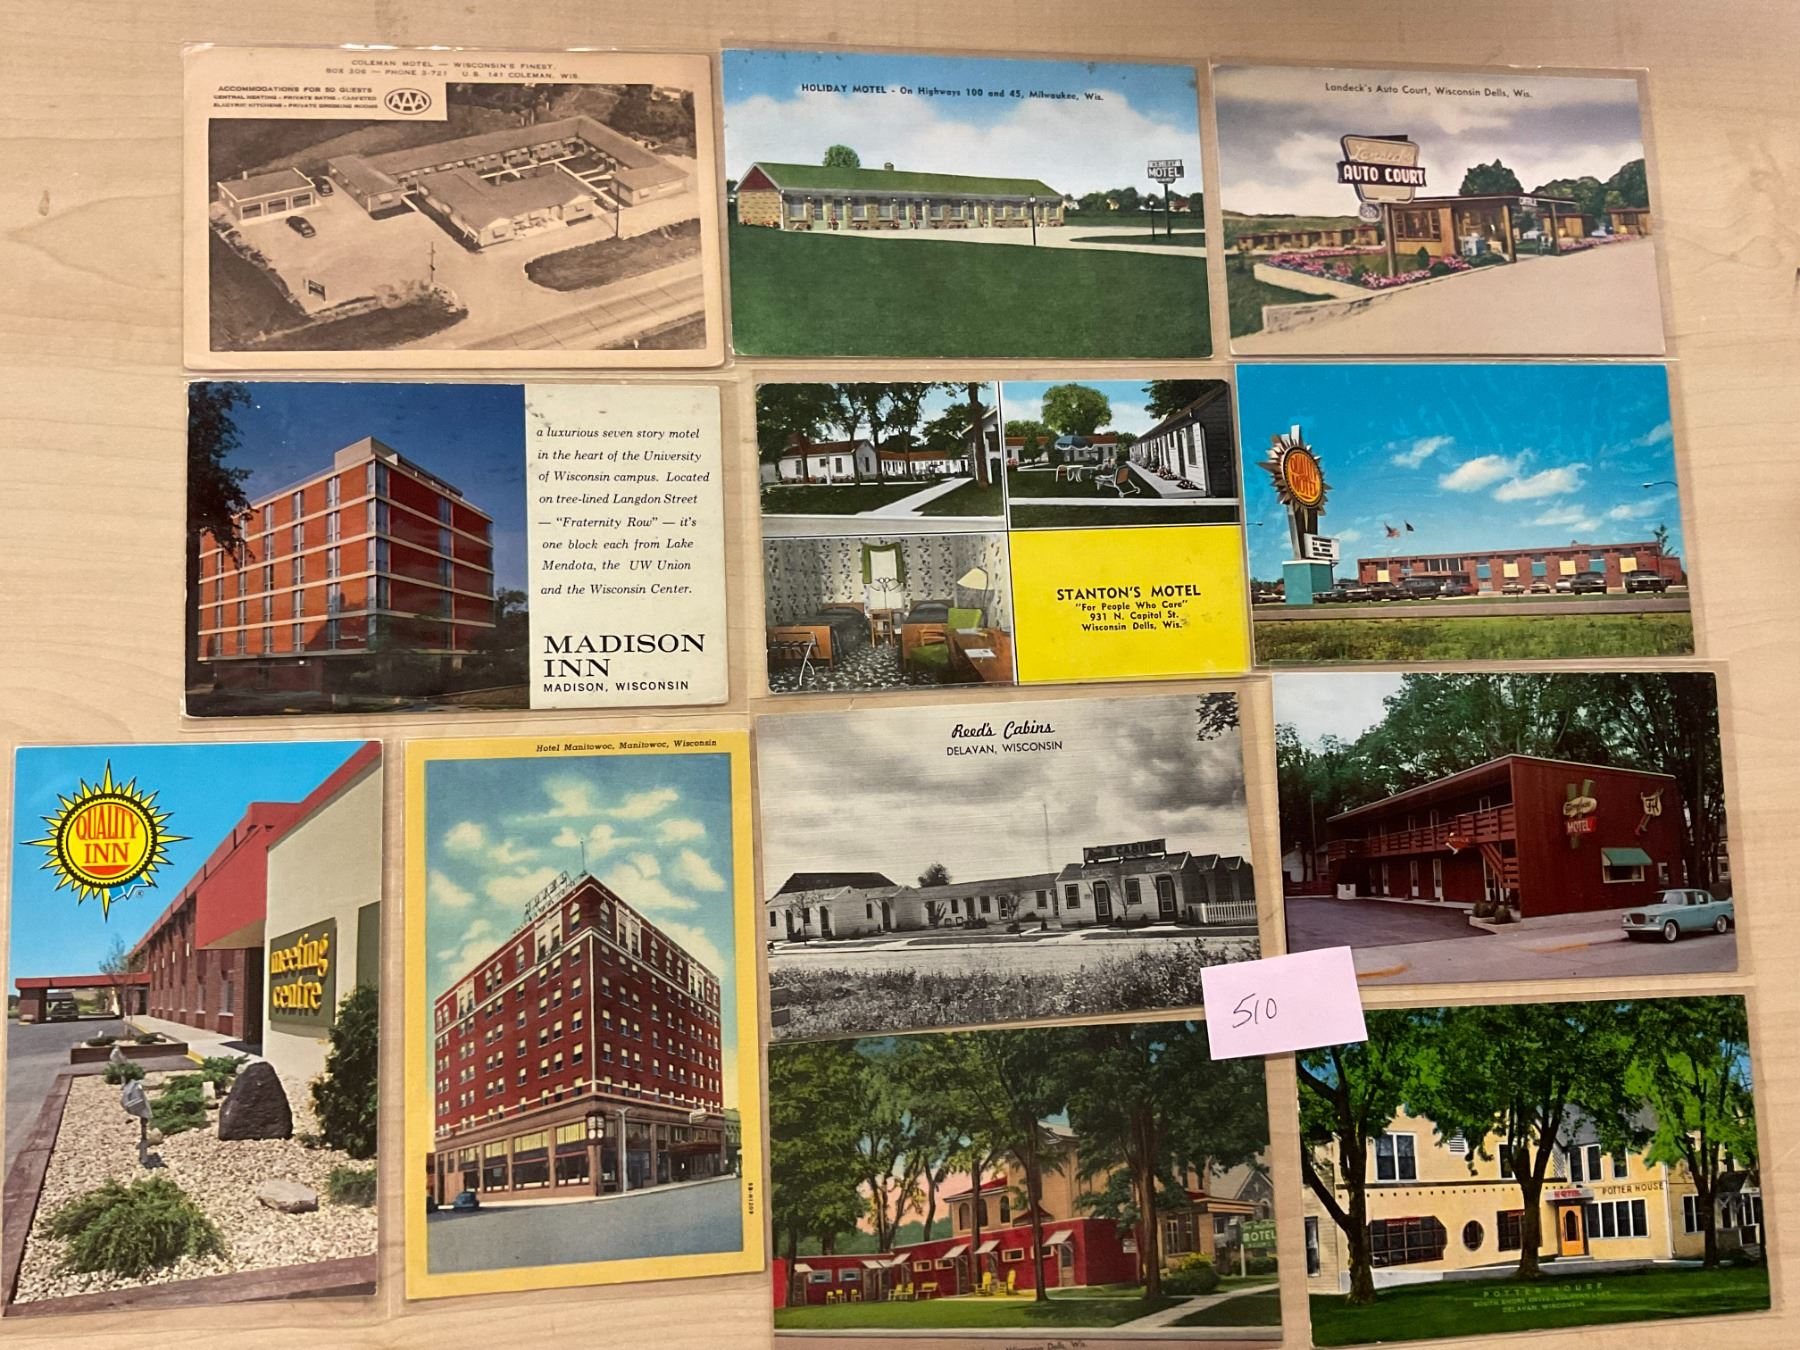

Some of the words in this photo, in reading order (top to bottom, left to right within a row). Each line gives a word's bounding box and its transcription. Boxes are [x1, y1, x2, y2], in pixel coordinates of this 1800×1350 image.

[351, 59, 396, 67] COLEMAN
[402, 60, 433, 68] MOTEL
[453, 61, 515, 69] WISCONSIN'S
[325, 67, 344, 75] BOX
[801, 83, 848, 93] HOLIDAY
[852, 84, 887, 94] MOTEL
[899, 86, 913, 95] On
[917, 87, 961, 97] Highways
[965, 88, 983, 97] 100
[987, 89, 1005, 98] and
[1009, 89, 1025, 99] 45,
[1029, 90, 1079, 101] Milwaukee,
[1084, 92, 1104, 101] Wis.
[1325, 82, 1372, 93] Landeck's
[1376, 84, 1398, 94] Auto
[1401, 86, 1431, 96] Court,
[1435, 86, 1480, 97] Wisconsin
[1484, 87, 1510, 98] Dells,
[1513, 89, 1533, 98] Wis.
[1148, 167, 1180, 177] MOTEL
[1343, 164, 1378, 182] AUTO
[1384, 167, 1424, 185] COURT
[547, 428, 599, 437] luxurious
[602, 430, 633, 438] seven
[636, 430, 664, 440] story
[668, 429, 699, 438] motel
[537, 450, 549, 459] in
[552, 450, 571, 460] the
[574, 450, 603, 460] heart
[607, 450, 619, 462] of
[622, 450, 640, 460] the
[643, 450, 702, 463] University
[538, 471, 550, 482] of
[554, 471, 610, 481] Wisconsin
[613, 473, 659, 483] campus.
[666, 472, 710, 482] Located
[539, 496, 553, 504] on
[556, 494, 609, 504] tree-lined
[613, 494, 661, 505] Langdon
[663, 493, 698, 503] Street
[542, 541, 562, 549] one
[568, 539, 598, 549] block
[603, 539, 629, 549] each
[634, 538, 660, 550] from
[666, 538, 694, 549] Lake
[542, 560, 597, 572] Mendota,
[602, 560, 620, 570] the
[629, 560, 652, 571] UW
[657, 559, 691, 570] Union
[541, 585, 562, 595] and
[567, 584, 586, 594] the
[590, 584, 645, 594] Wisconsin
[650, 583, 692, 594] Center.
[1057, 586, 1141, 601] STANTON'S
[1151, 584, 1201, 598] MOTEL
[1101, 602, 1130, 611] People
[1136, 601, 1156, 609] Who
[1090, 613, 1106, 621] 931
[1113, 612, 1125, 620] N.
[1167, 610, 1179, 619] St.
[1081, 623, 1126, 632] Wisconsin
[1132, 621, 1157, 631] Dells,
[1162, 620, 1183, 629] Wis.
[543, 633, 705, 654] MADISON
[543, 658, 611, 678] INN
[543, 682, 609, 693] MADISON,
[615, 681, 689, 691] WISCONSIN
[951, 722, 997, 738] Reed's
[1003, 719, 1055, 739] Cabins
[535, 744, 560, 752] Hotel
[563, 742, 615, 751] Manitowoc,
[619, 740, 669, 749] Manitowoc,
[673, 739, 717, 747] Wisconsin
[946, 745, 997, 756] DELAVAN,
[1002, 741, 1063, 752] WISCONSIN
[75, 804, 139, 840] QUALITY
[1567, 820, 1591, 833] MOTEL
[84, 842, 130, 864] INN
[271, 932, 329, 977] meeting
[273, 975, 323, 1010] centre
[1231, 993, 1278, 1029] 510
[1602, 1186, 1632, 1196] POTTER
[1635, 1182, 1664, 1191] HOUSE
[1483, 1288, 1541, 1298] POTTER
[1552, 1282, 1602, 1292] HOUSE
